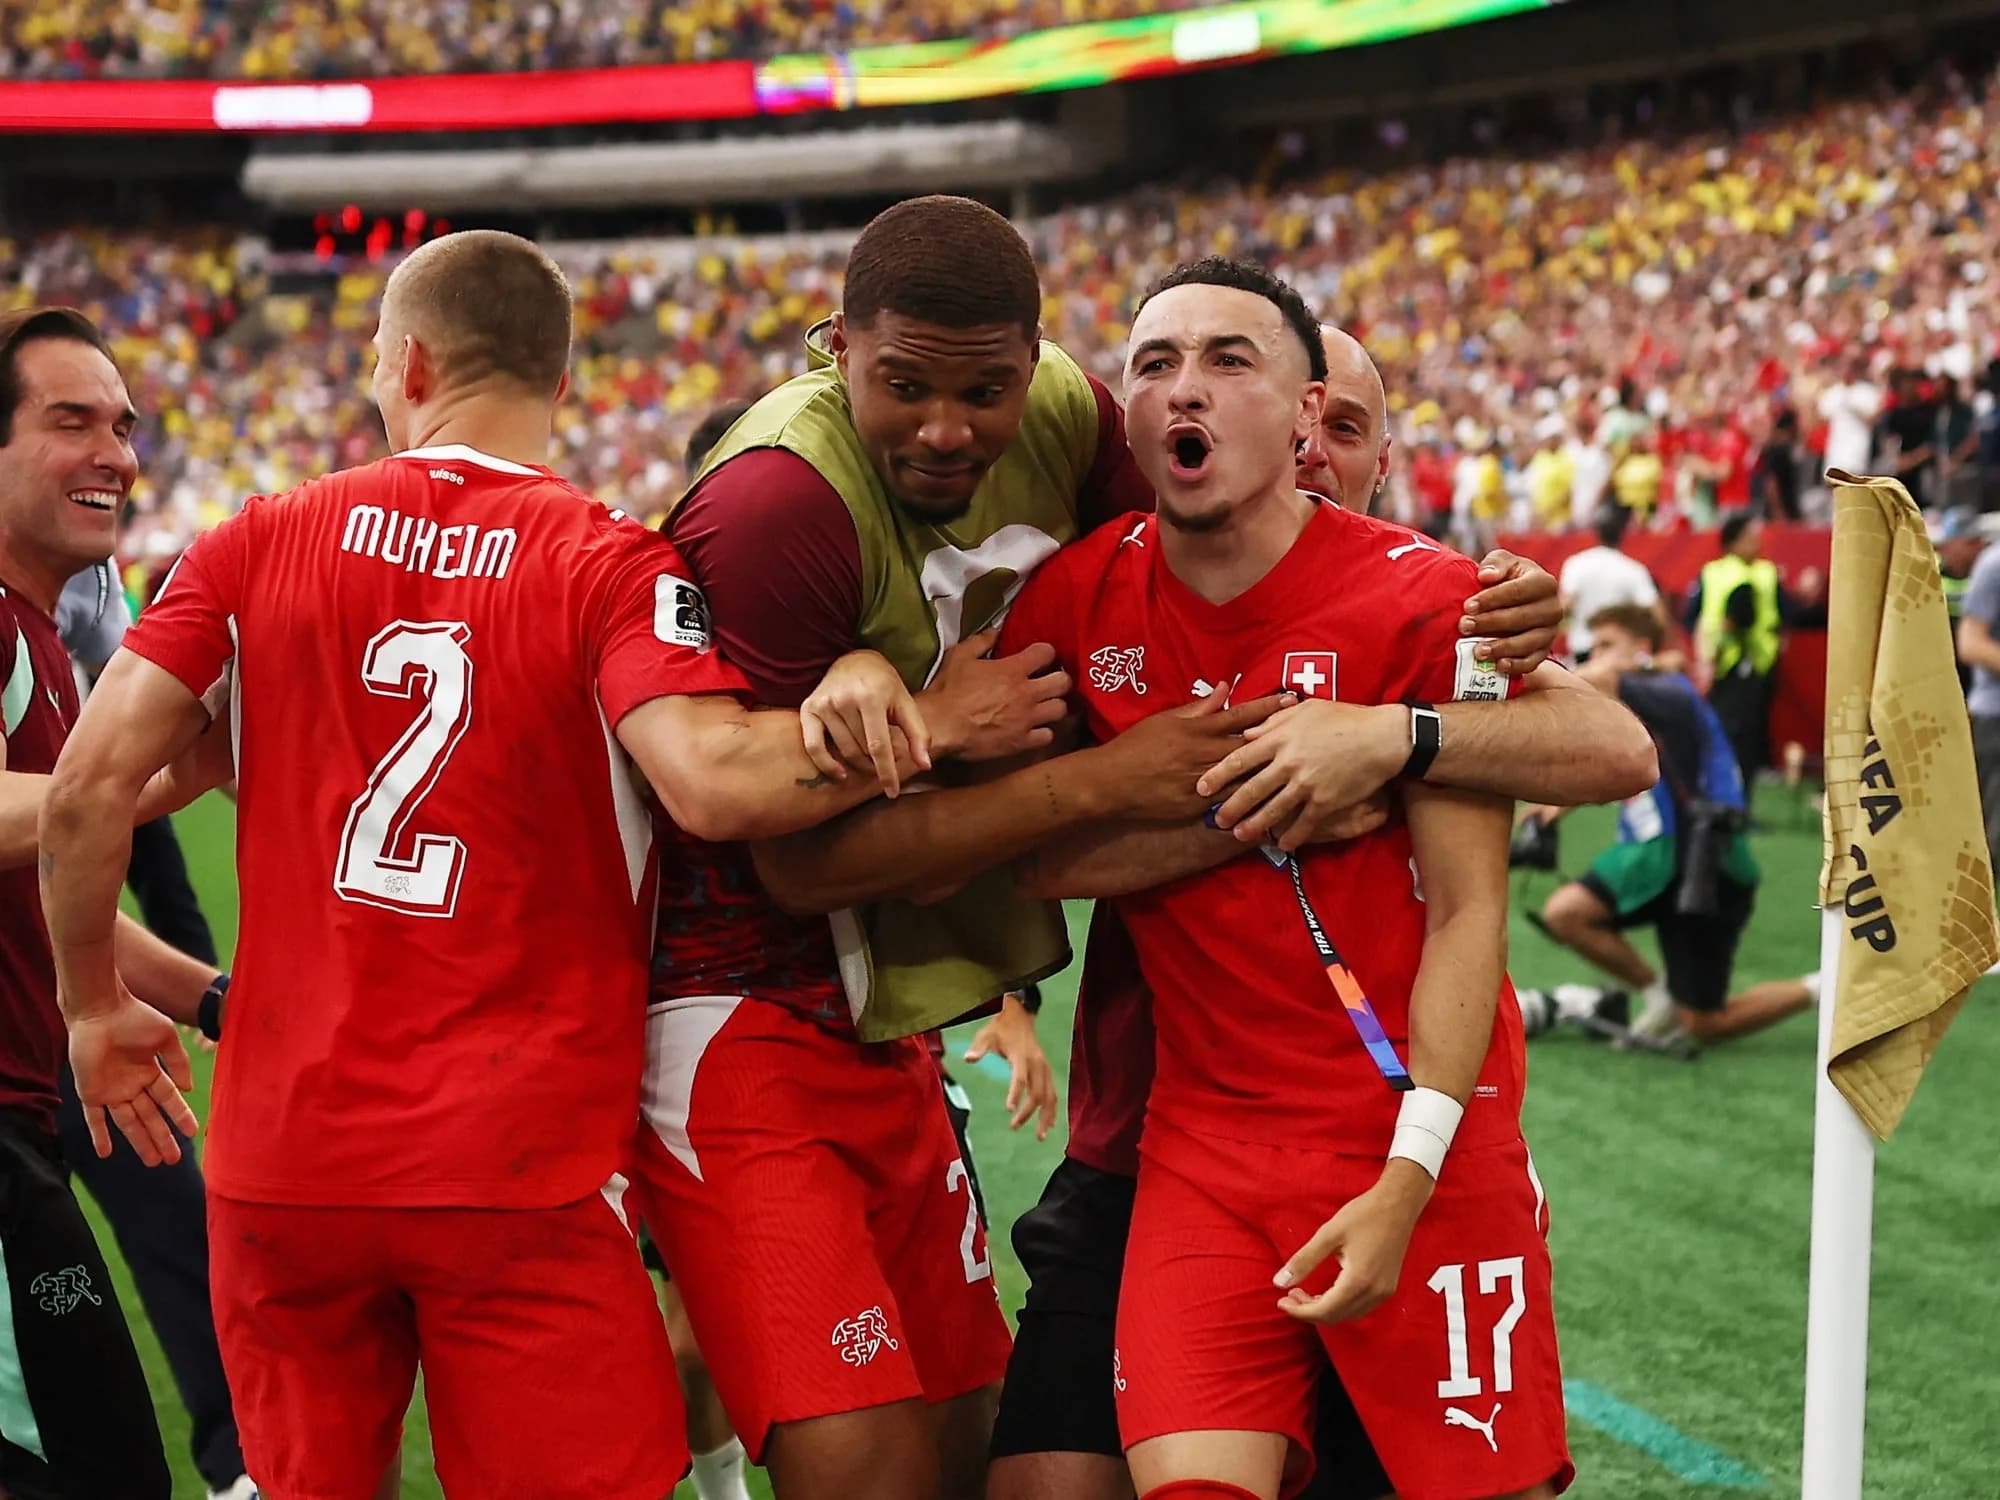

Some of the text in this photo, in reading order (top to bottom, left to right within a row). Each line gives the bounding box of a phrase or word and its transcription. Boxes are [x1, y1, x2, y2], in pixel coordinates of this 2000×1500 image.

[340, 504, 517, 579] MUHEIM
[333, 619, 473, 918] 2
[1312, 930, 1334, 956] FIFA
[1426, 1256, 1526, 1399] 17
